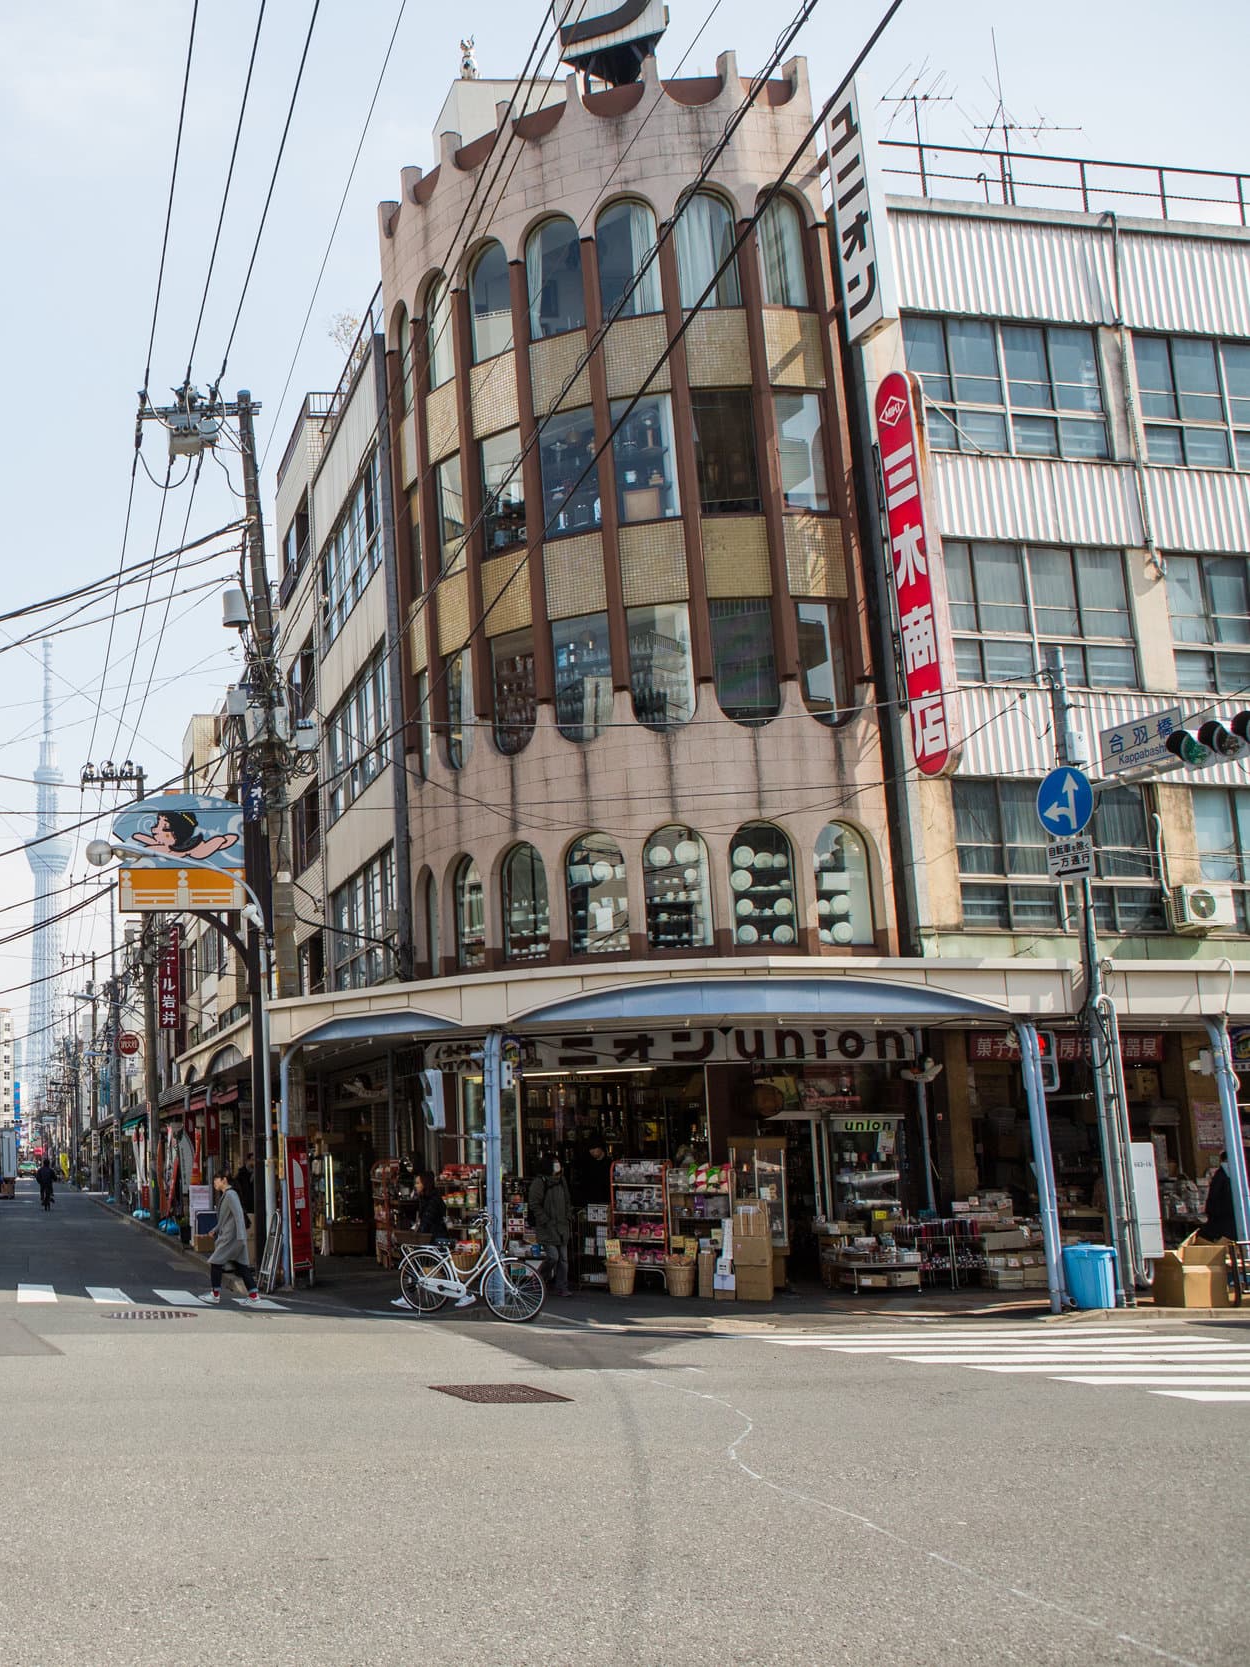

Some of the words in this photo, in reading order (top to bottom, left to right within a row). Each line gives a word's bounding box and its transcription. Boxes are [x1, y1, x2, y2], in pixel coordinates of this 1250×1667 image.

[830, 102, 876, 320] ユニオン
[883, 442, 946, 759] 三木商店
[1109, 716, 1174, 754] 合羽橋
[1048, 841, 1090, 857] 自転車を除く
[1050, 852, 1090, 868] 一方通行
[736, 1027, 908, 1060] union
[845, 1121, 891, 1131] union
